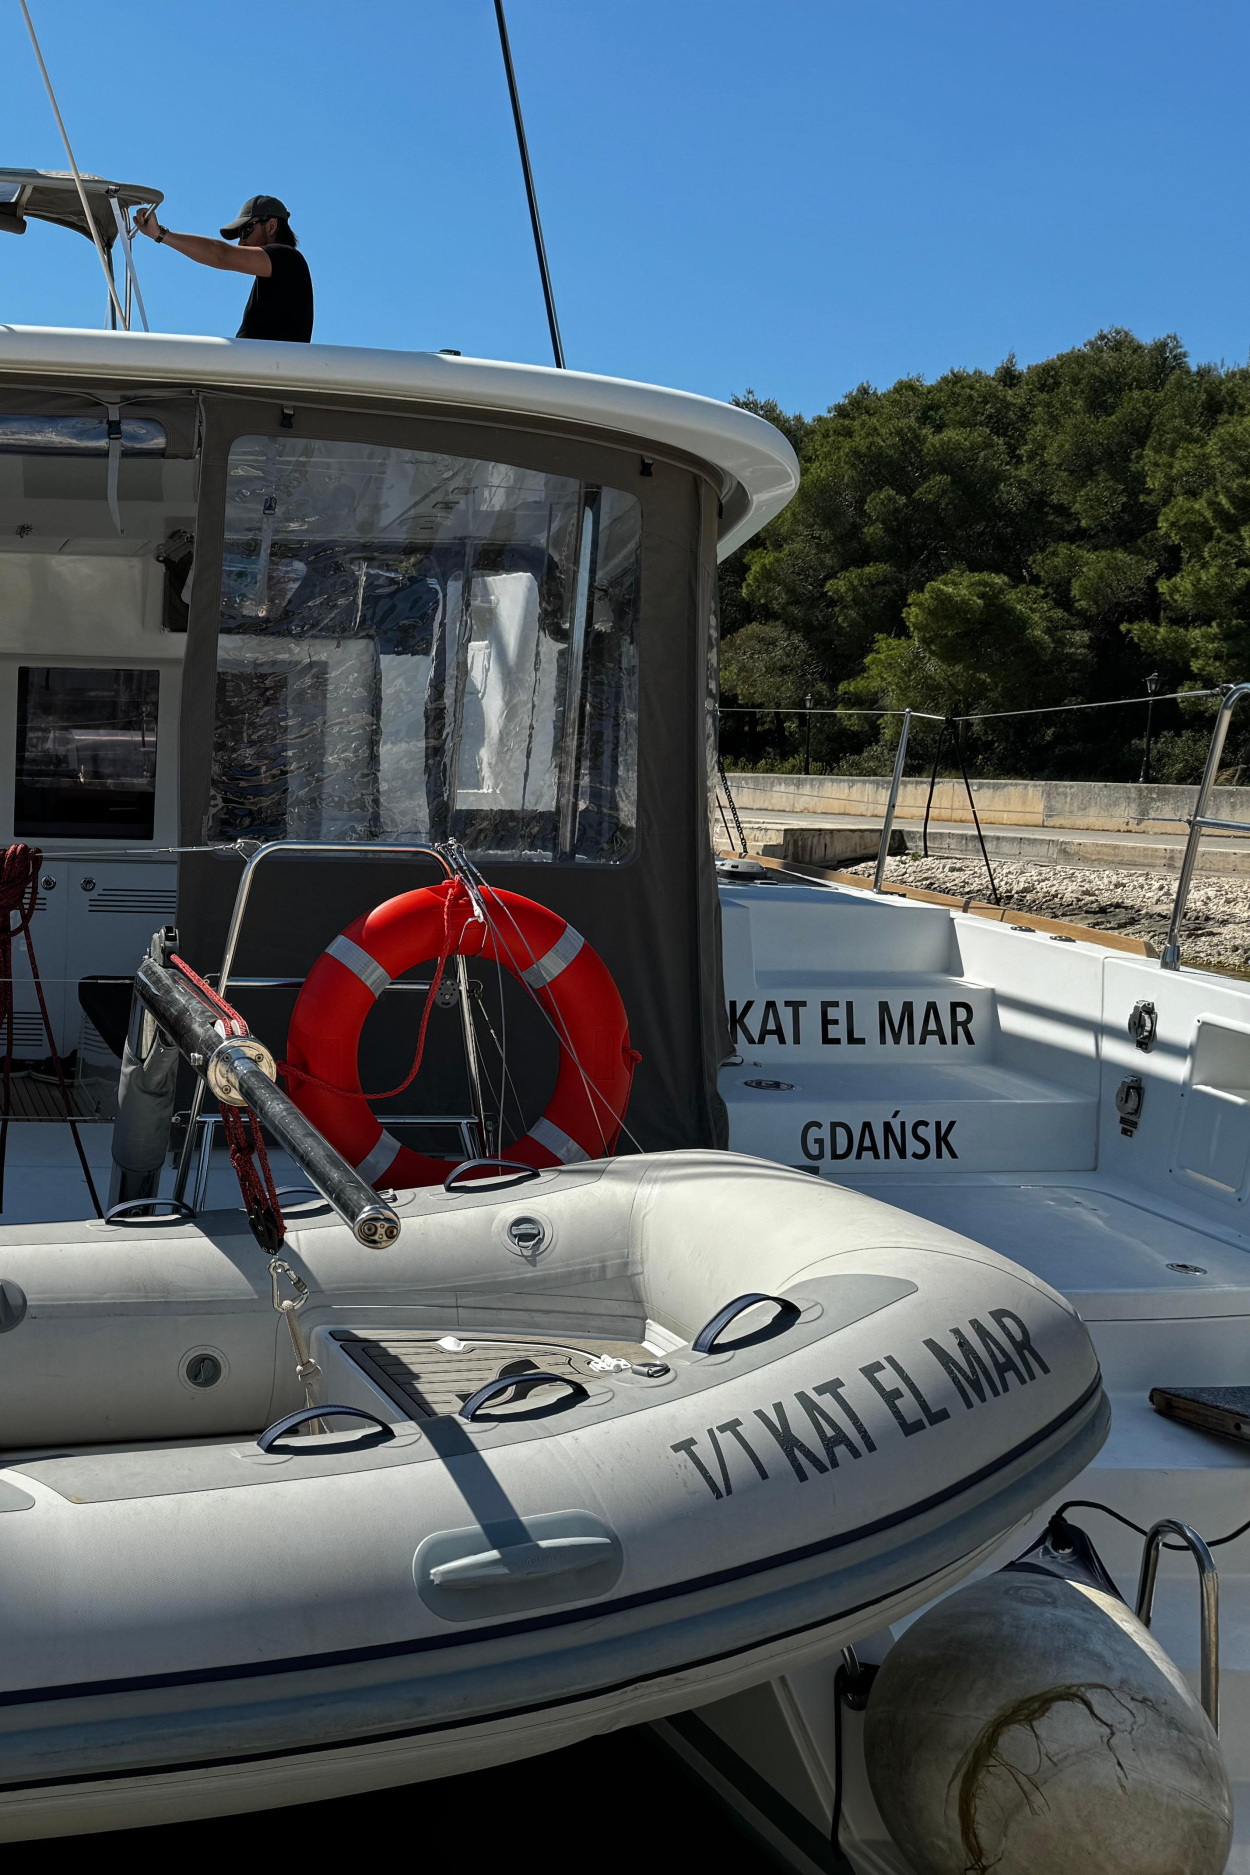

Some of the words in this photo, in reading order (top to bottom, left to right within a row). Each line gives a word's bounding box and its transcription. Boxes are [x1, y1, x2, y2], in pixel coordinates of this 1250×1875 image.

[729, 1000, 807, 1045] KAT
[820, 1001, 866, 1045] EL
[878, 1001, 975, 1045] MAR
[801, 1110, 959, 1161] GDAŃSK
[670, 1418, 769, 1500] T/T
[753, 1377, 877, 1482] KAT
[859, 1355, 950, 1437] EL
[922, 1308, 1050, 1409] MAR
